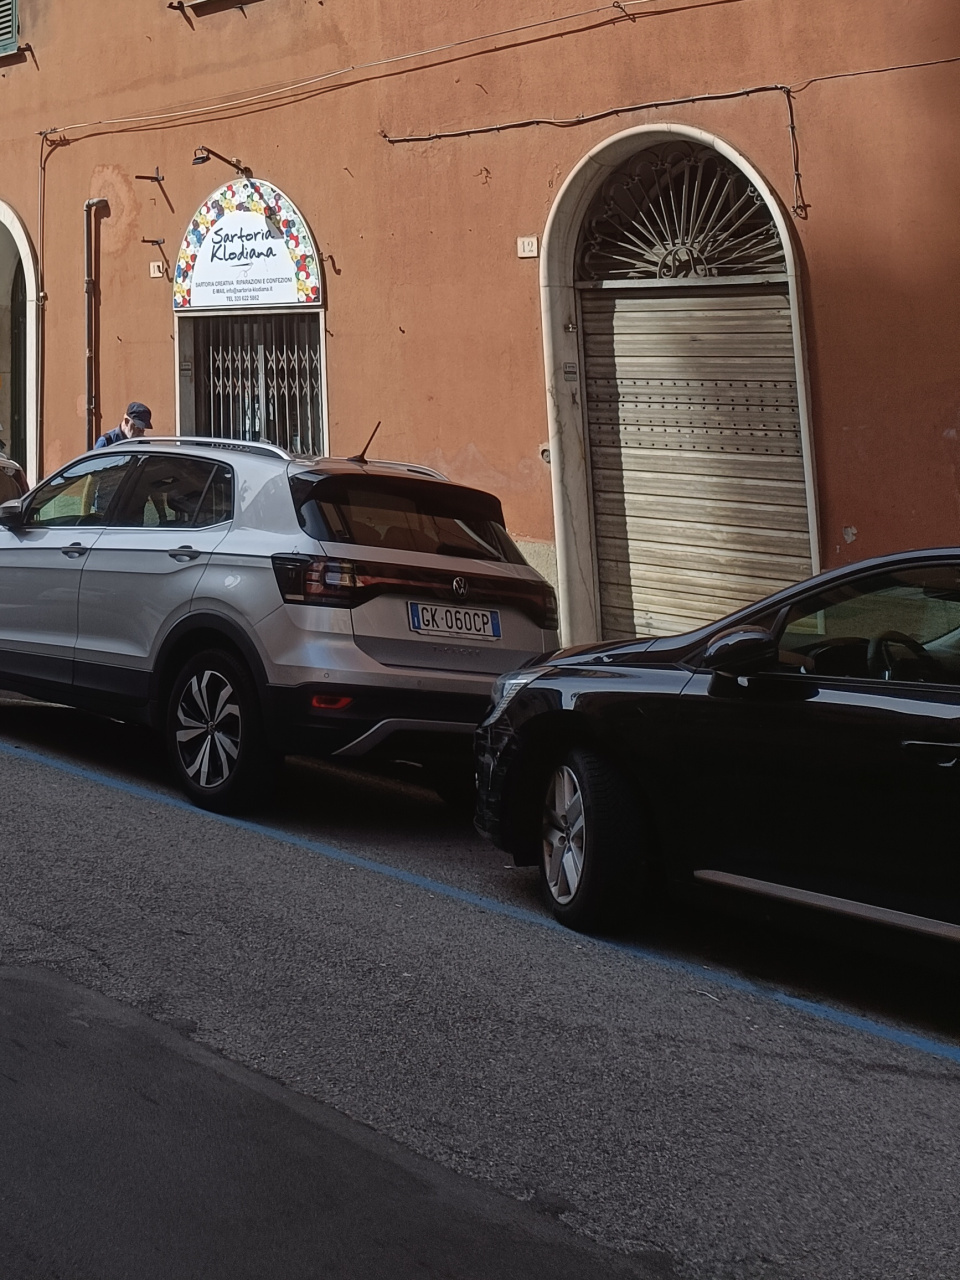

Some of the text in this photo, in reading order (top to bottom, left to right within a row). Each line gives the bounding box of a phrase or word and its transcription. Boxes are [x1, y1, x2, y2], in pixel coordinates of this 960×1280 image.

[212, 226, 275, 245] Sartoria
[210, 244, 276, 263] Klodiana
[521, 240, 534, 253] 12
[421, 606, 489, 633] GK 060CP
